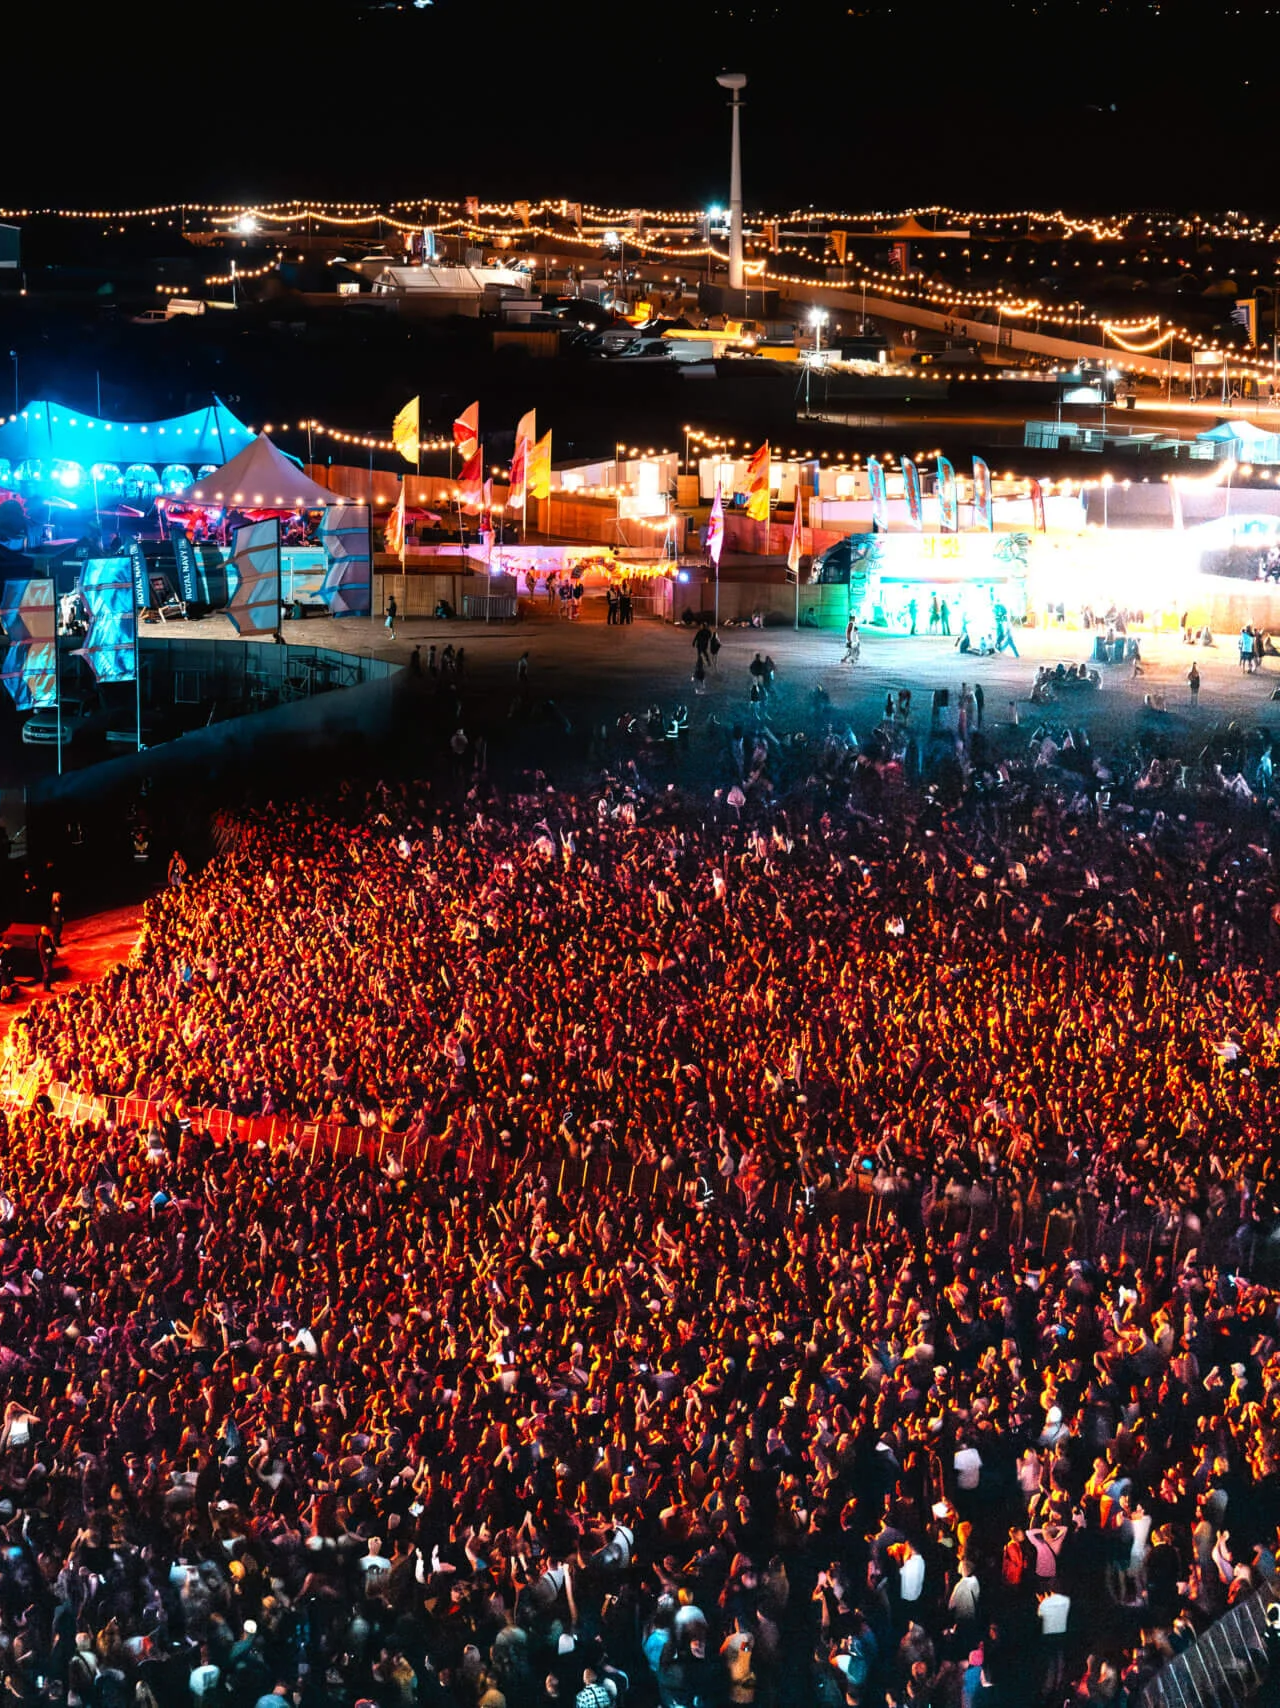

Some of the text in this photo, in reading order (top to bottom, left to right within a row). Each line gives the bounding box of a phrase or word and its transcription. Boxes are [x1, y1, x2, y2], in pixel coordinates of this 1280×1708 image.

[179, 550, 190, 573] NAVY
[135, 578, 145, 605] ROYAL
[183, 573, 193, 600] ROYAL
